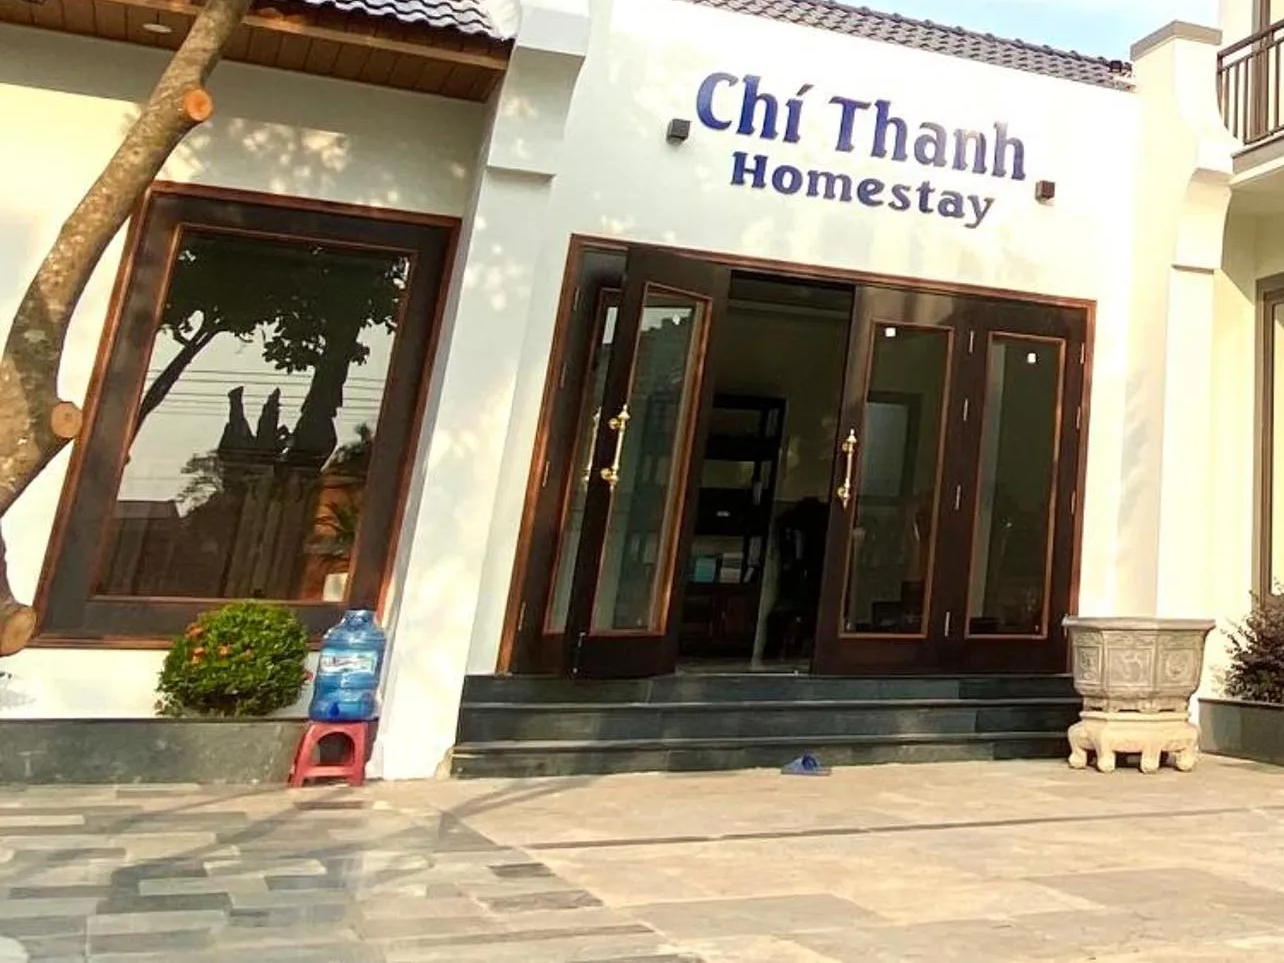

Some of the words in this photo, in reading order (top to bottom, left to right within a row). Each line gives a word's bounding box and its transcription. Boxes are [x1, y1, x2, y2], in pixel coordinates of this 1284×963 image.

[696, 72, 814, 143] Chí
[829, 96, 1026, 181] Thanh
[731, 151, 995, 229] Homestay
